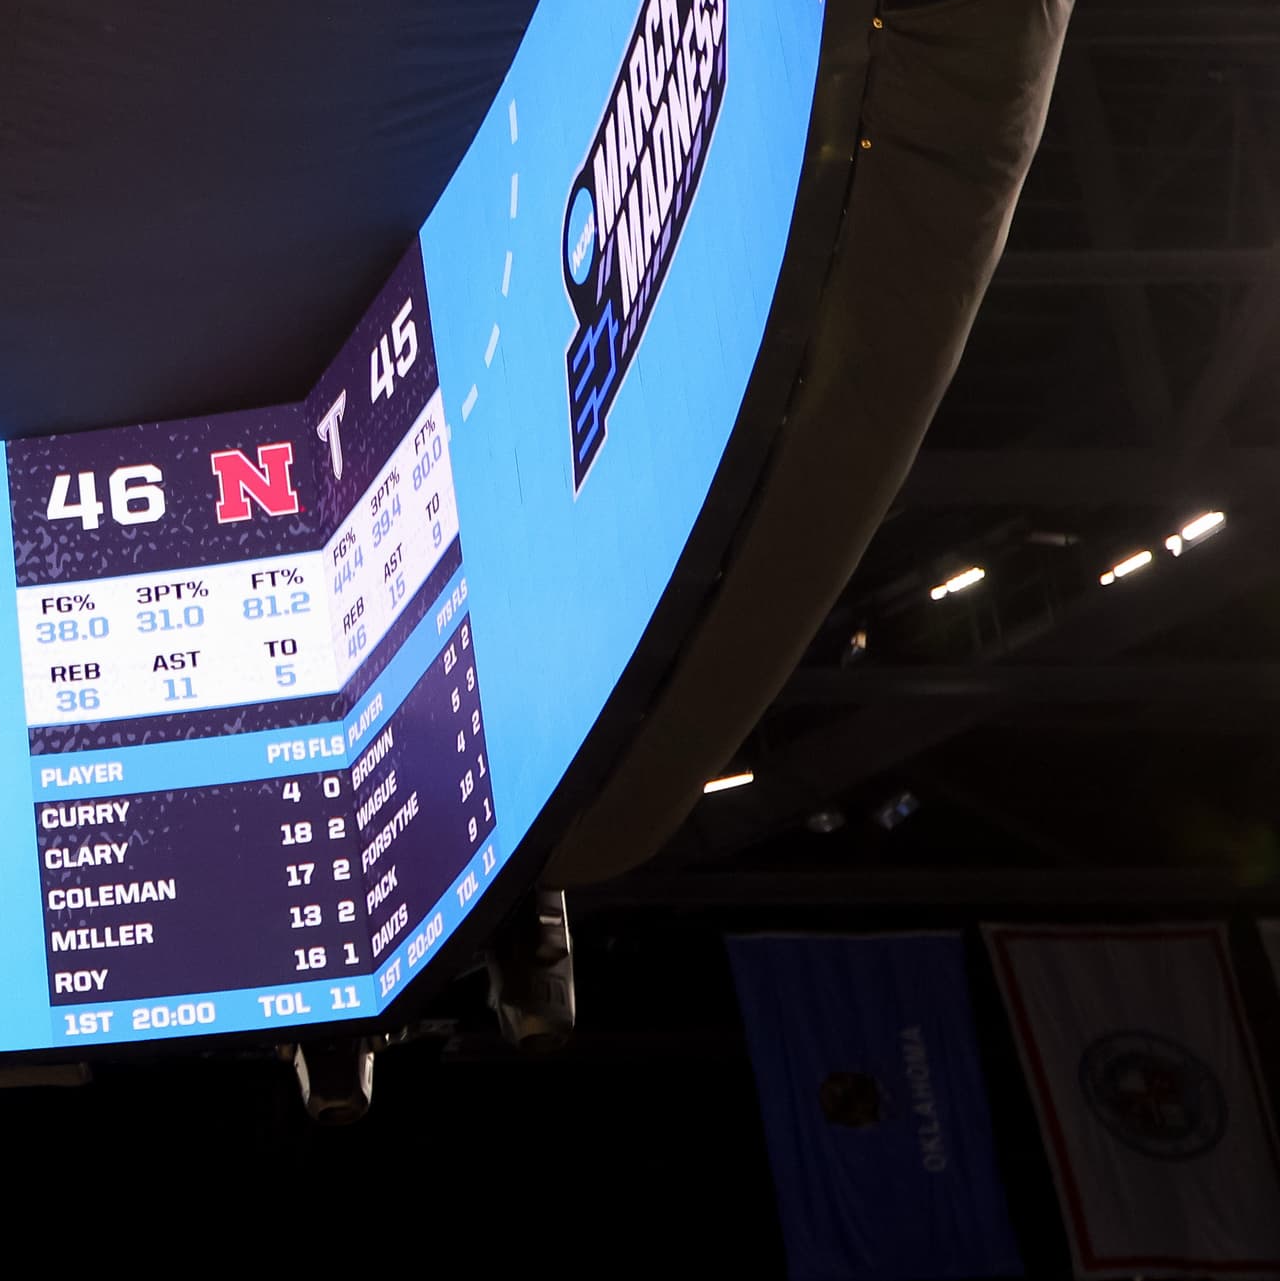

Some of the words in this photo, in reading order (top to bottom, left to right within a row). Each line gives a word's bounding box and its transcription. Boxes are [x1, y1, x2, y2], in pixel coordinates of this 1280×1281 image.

[570, 207, 600, 277] NCAA
[370, 297, 419, 405] 45
[414, 418, 436, 457] FT%
[45, 464, 167, 531] 46
[210, 442, 300, 525] N
[36, 616, 110, 645] 38.0
[137, 605, 205, 634] 31.0
[242, 591, 312, 620] 81.2
[40, 593, 96, 615] FG%
[136, 581, 210, 605] 3PT%
[251, 568, 305, 591] FT%
[50, 662, 101, 684] REB
[151, 651, 202, 673] AST
[264, 638, 299, 659] TO
[56, 687, 101, 712] 36
[163, 677, 199, 701] 11
[276, 663, 298, 687] 5
[40, 762, 124, 788] PLAYER
[267, 742, 306, 764] PTS
[309, 736, 345, 760] FLS
[352, 726, 394, 792] BROWN
[41, 801, 130, 829] CURRY
[282, 781, 301, 803] 4
[323, 776, 340, 799] 0
[356, 770, 398, 833] WAGUE
[44, 843, 129, 870] CLARY
[280, 823, 313, 846] 18
[328, 817, 346, 840] 2
[361, 791, 420, 874] FORSYTHE
[48, 879, 176, 911] COLEMAN
[286, 863, 316, 888] 17
[332, 858, 351, 881] 2
[366, 865, 398, 916] PACK
[51, 922, 154, 953] MILLER
[290, 905, 323, 929] 13
[337, 900, 356, 923] 2
[371, 902, 409, 959] DAVIS
[380, 963, 403, 999] 1ST
[408, 912, 444, 967] 20:00
[457, 870, 480, 908] TOL
[482, 844, 497, 877] 11
[54, 968, 109, 994] ROY
[294, 948, 327, 971] 16
[343, 943, 359, 966] 1
[64, 1011, 115, 1036] 1ST
[132, 1002, 216, 1031] 20:00
[258, 994, 311, 1019] TOL
[330, 987, 360, 1010] 11
[899, 1024, 948, 1173] OKLAHOMA
